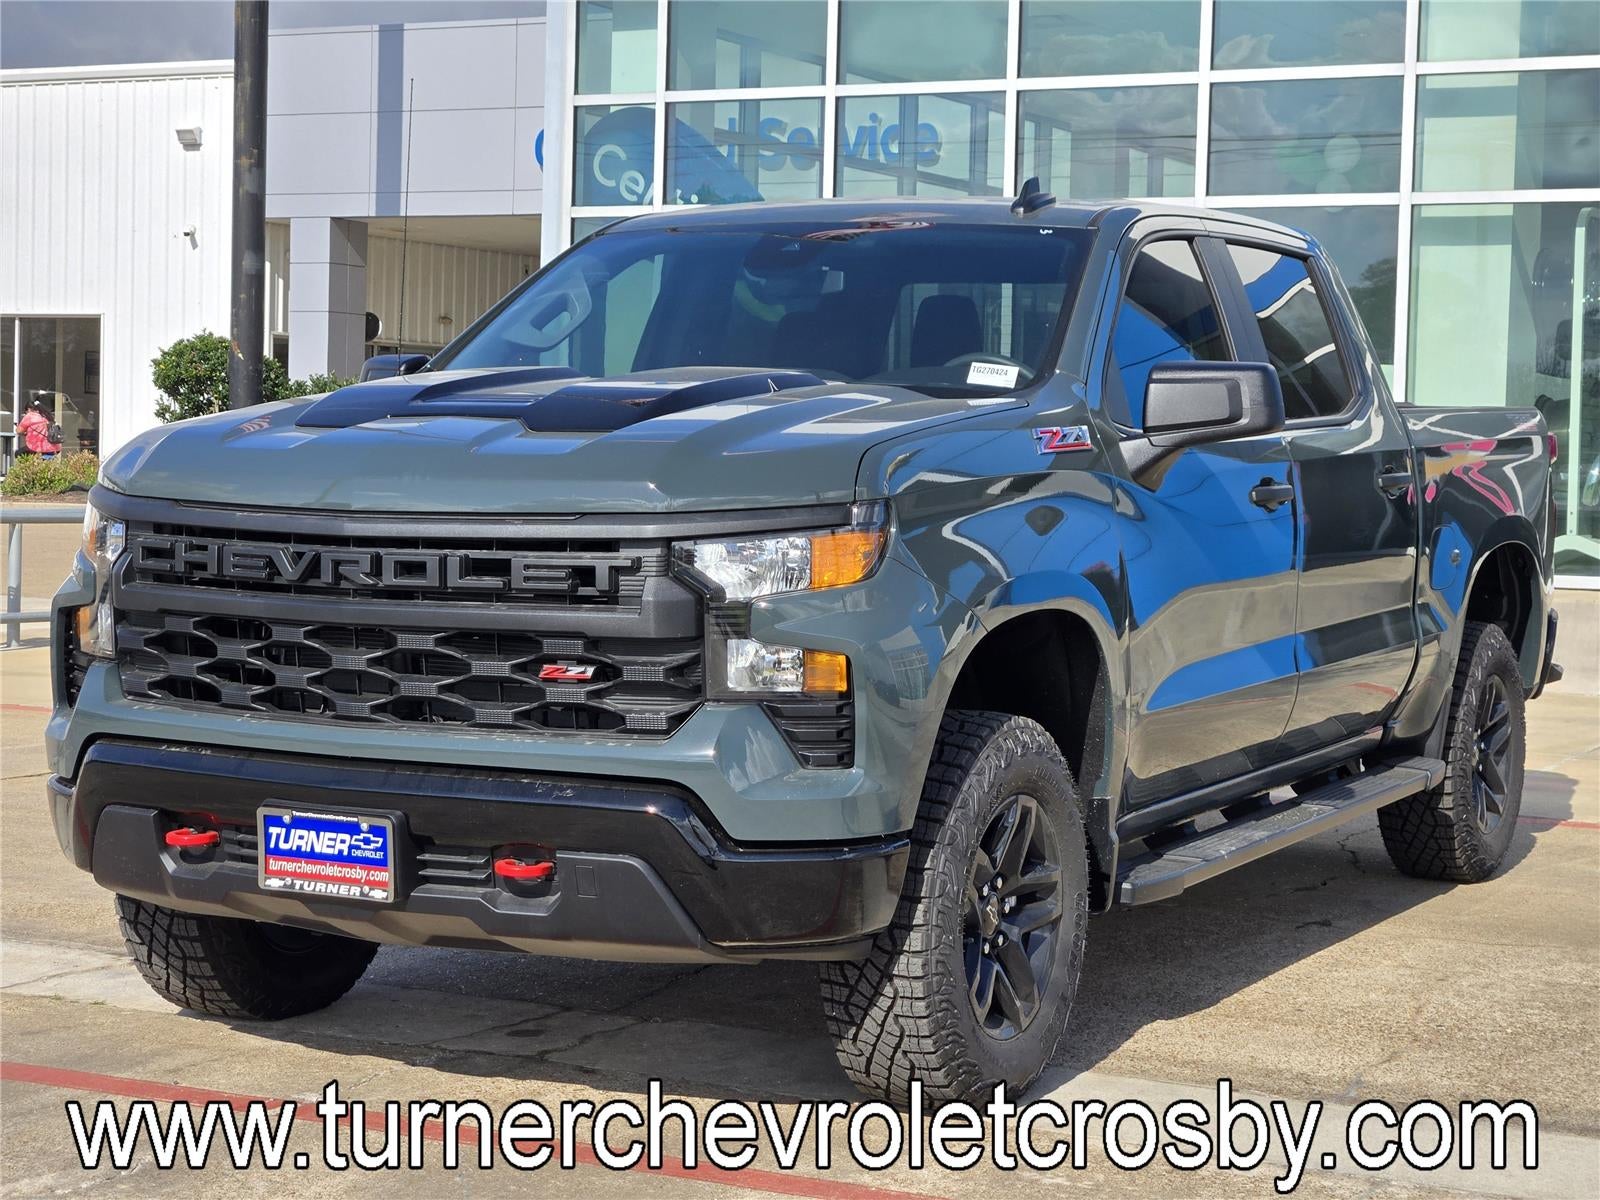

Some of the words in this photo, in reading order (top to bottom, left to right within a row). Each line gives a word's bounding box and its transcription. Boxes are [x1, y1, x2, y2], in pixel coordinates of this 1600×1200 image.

[758, 112, 940, 166] Sevice
[132, 538, 641, 594] CHEVROLET
[268, 826, 351, 856] TURNER
[351, 848, 385, 859] CHEVROLET
[269, 859, 389, 882] turnerchevroletcrosby.com
[293, 880, 361, 896] TURNER
